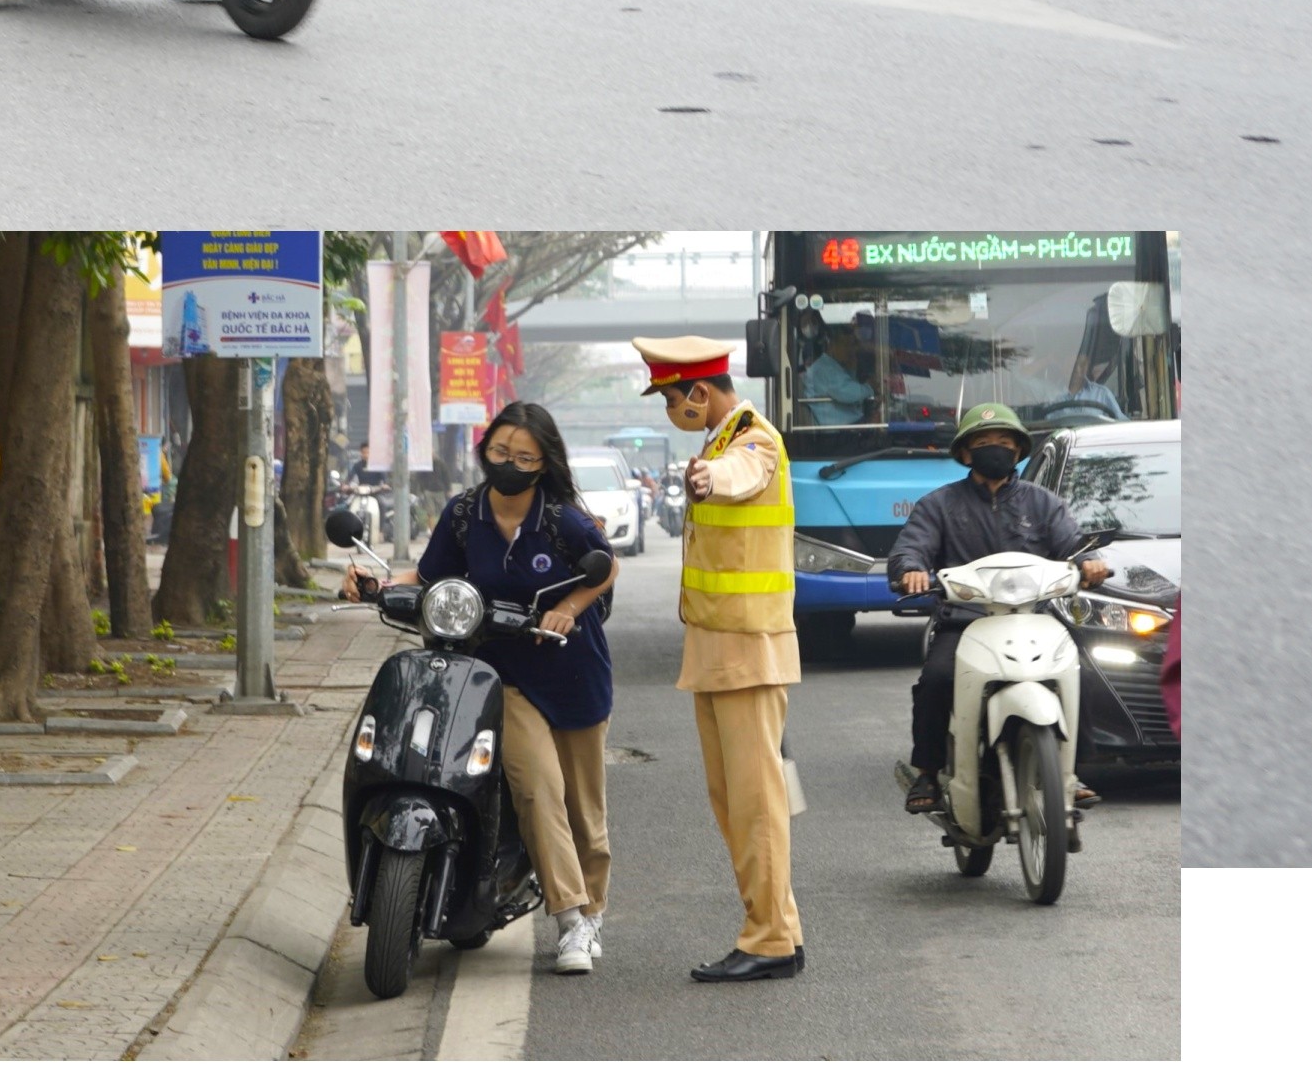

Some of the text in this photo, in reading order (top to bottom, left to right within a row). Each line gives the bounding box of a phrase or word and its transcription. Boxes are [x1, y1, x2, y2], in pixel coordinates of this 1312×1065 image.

[822, 231, 1132, 271] 48 BX NƯỚC NGẦM PHÚC LỢI
[221, 310, 311, 321] BỆNH VIỆN ĐA KHOA
[222, 321, 311, 335] QUỐC TẾ BẮC HÀ
